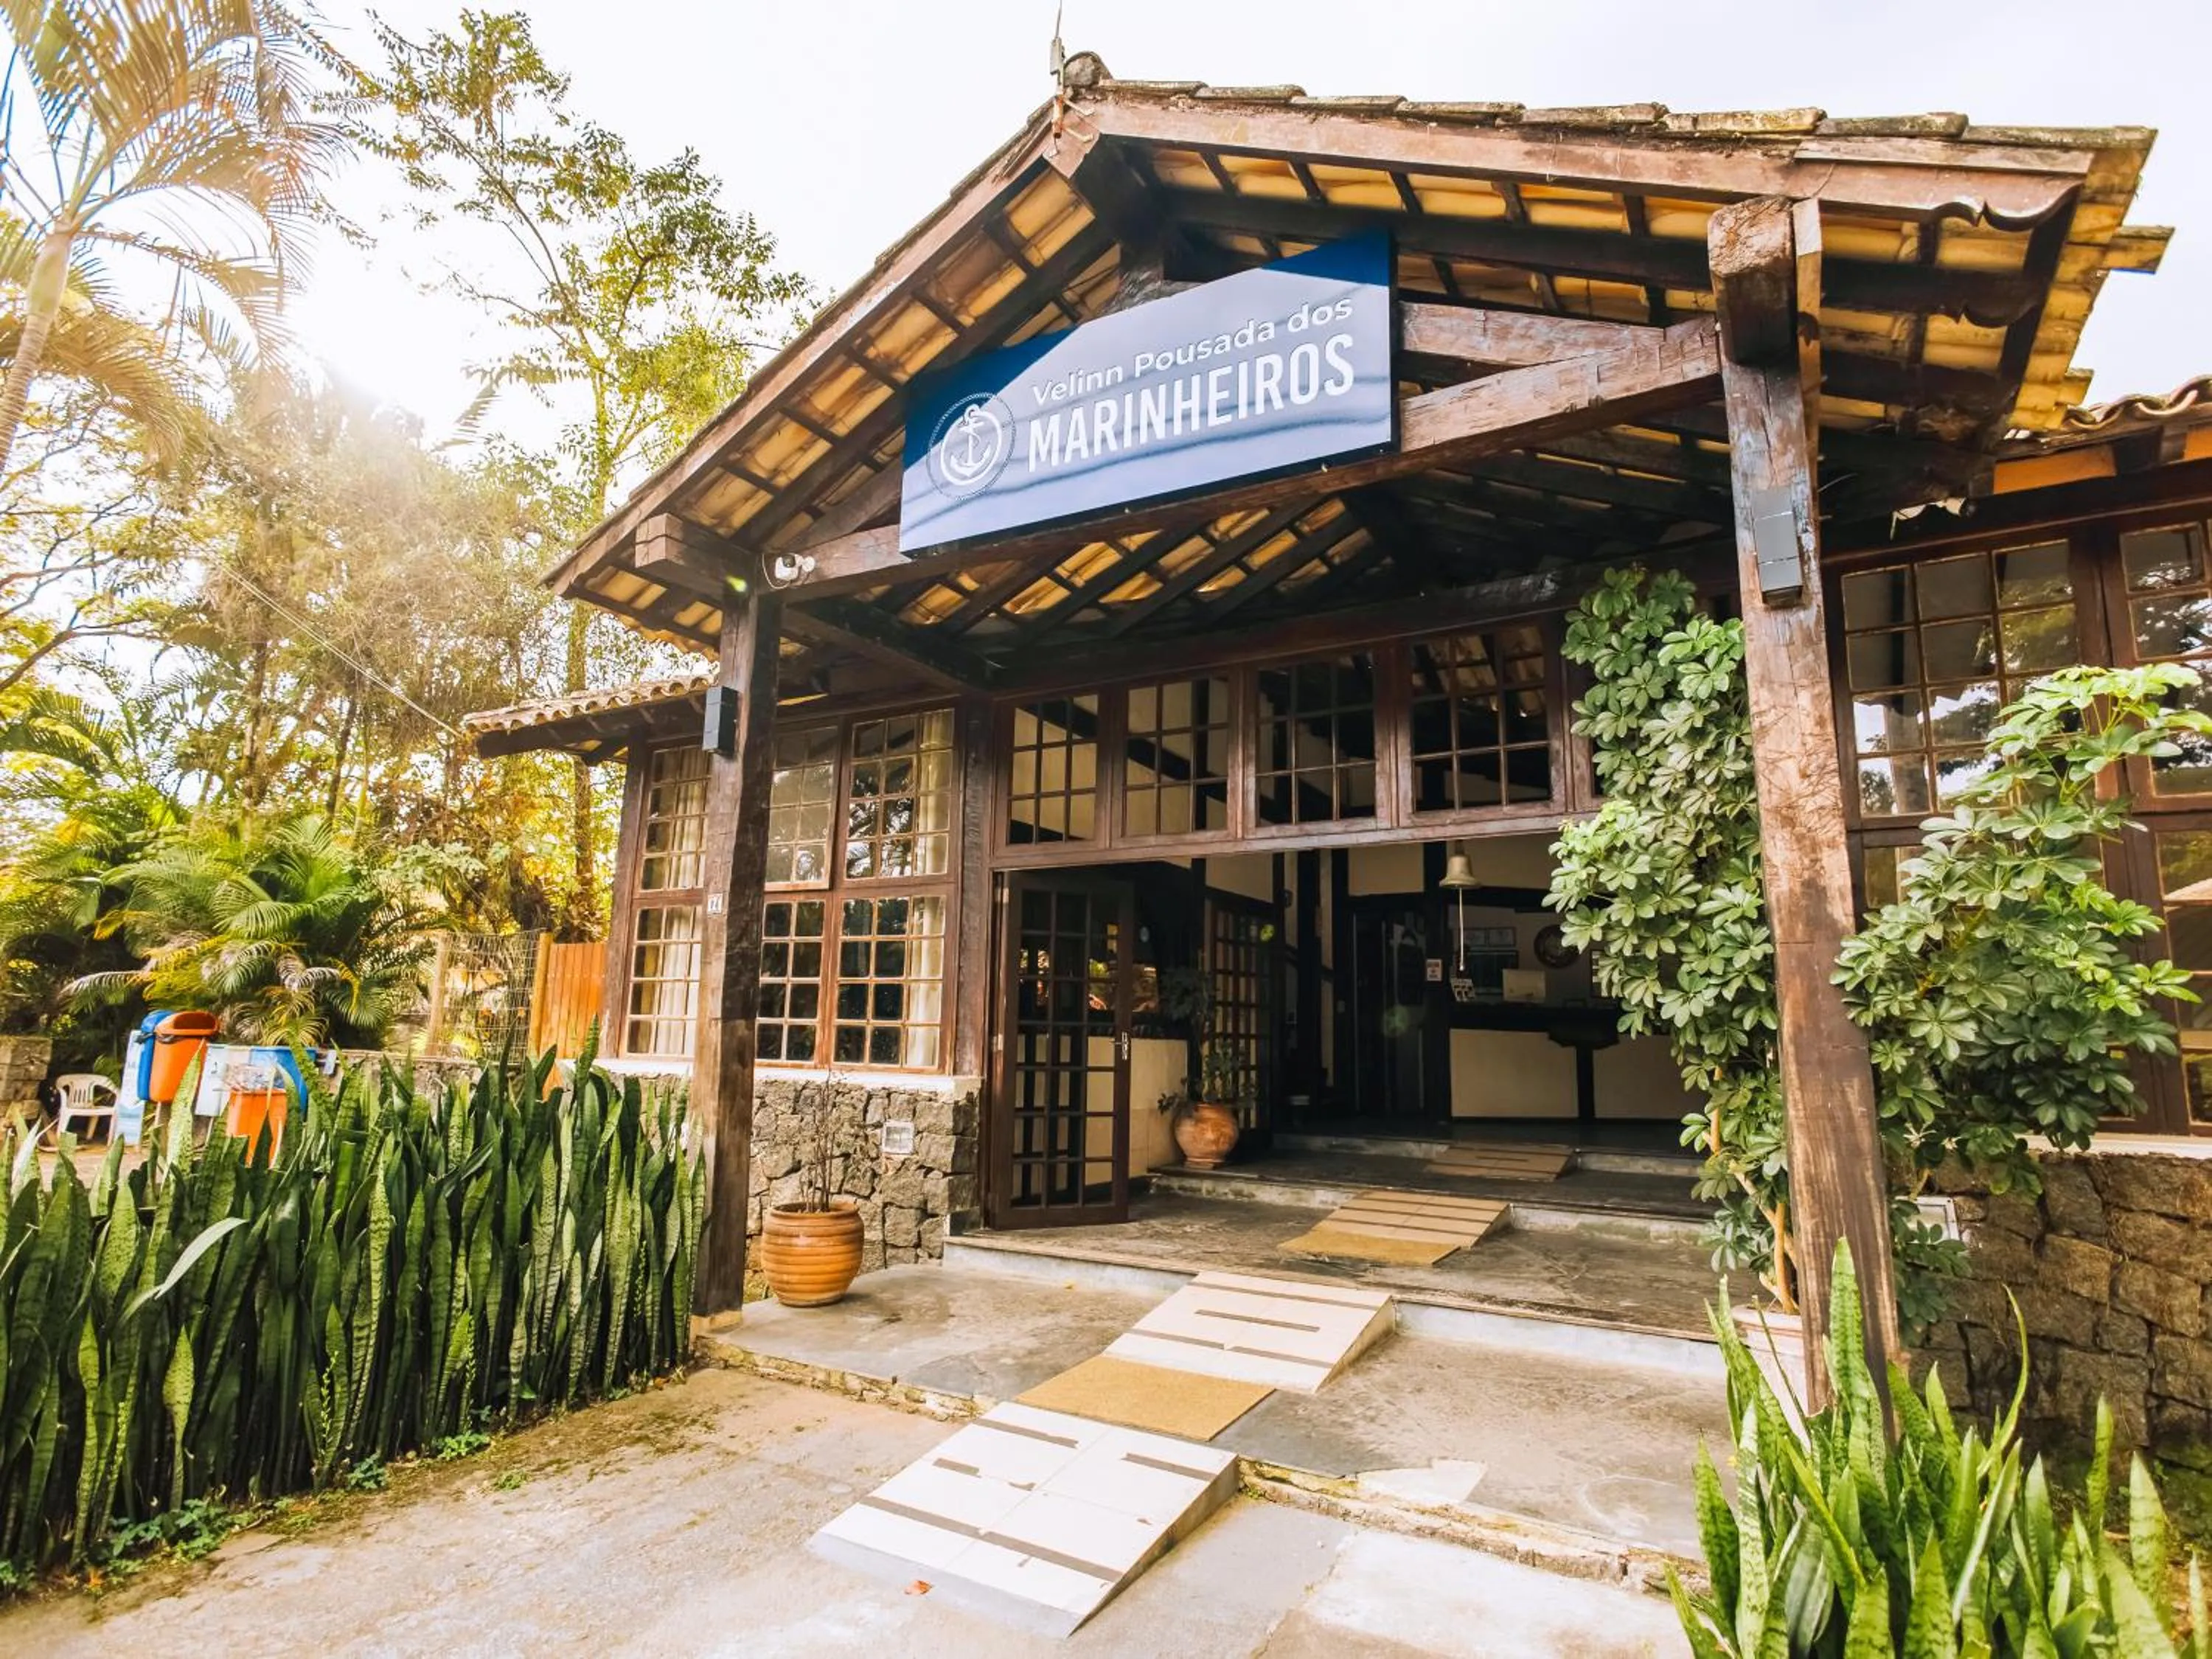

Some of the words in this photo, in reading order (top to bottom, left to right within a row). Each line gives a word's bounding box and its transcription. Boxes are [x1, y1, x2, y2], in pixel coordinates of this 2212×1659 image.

[1028, 333, 1354, 473] MARINHEIROS
[1032, 364, 1123, 406] Velinn
[1134, 319, 1276, 378] Pousada
[1287, 297, 1354, 333] dos
